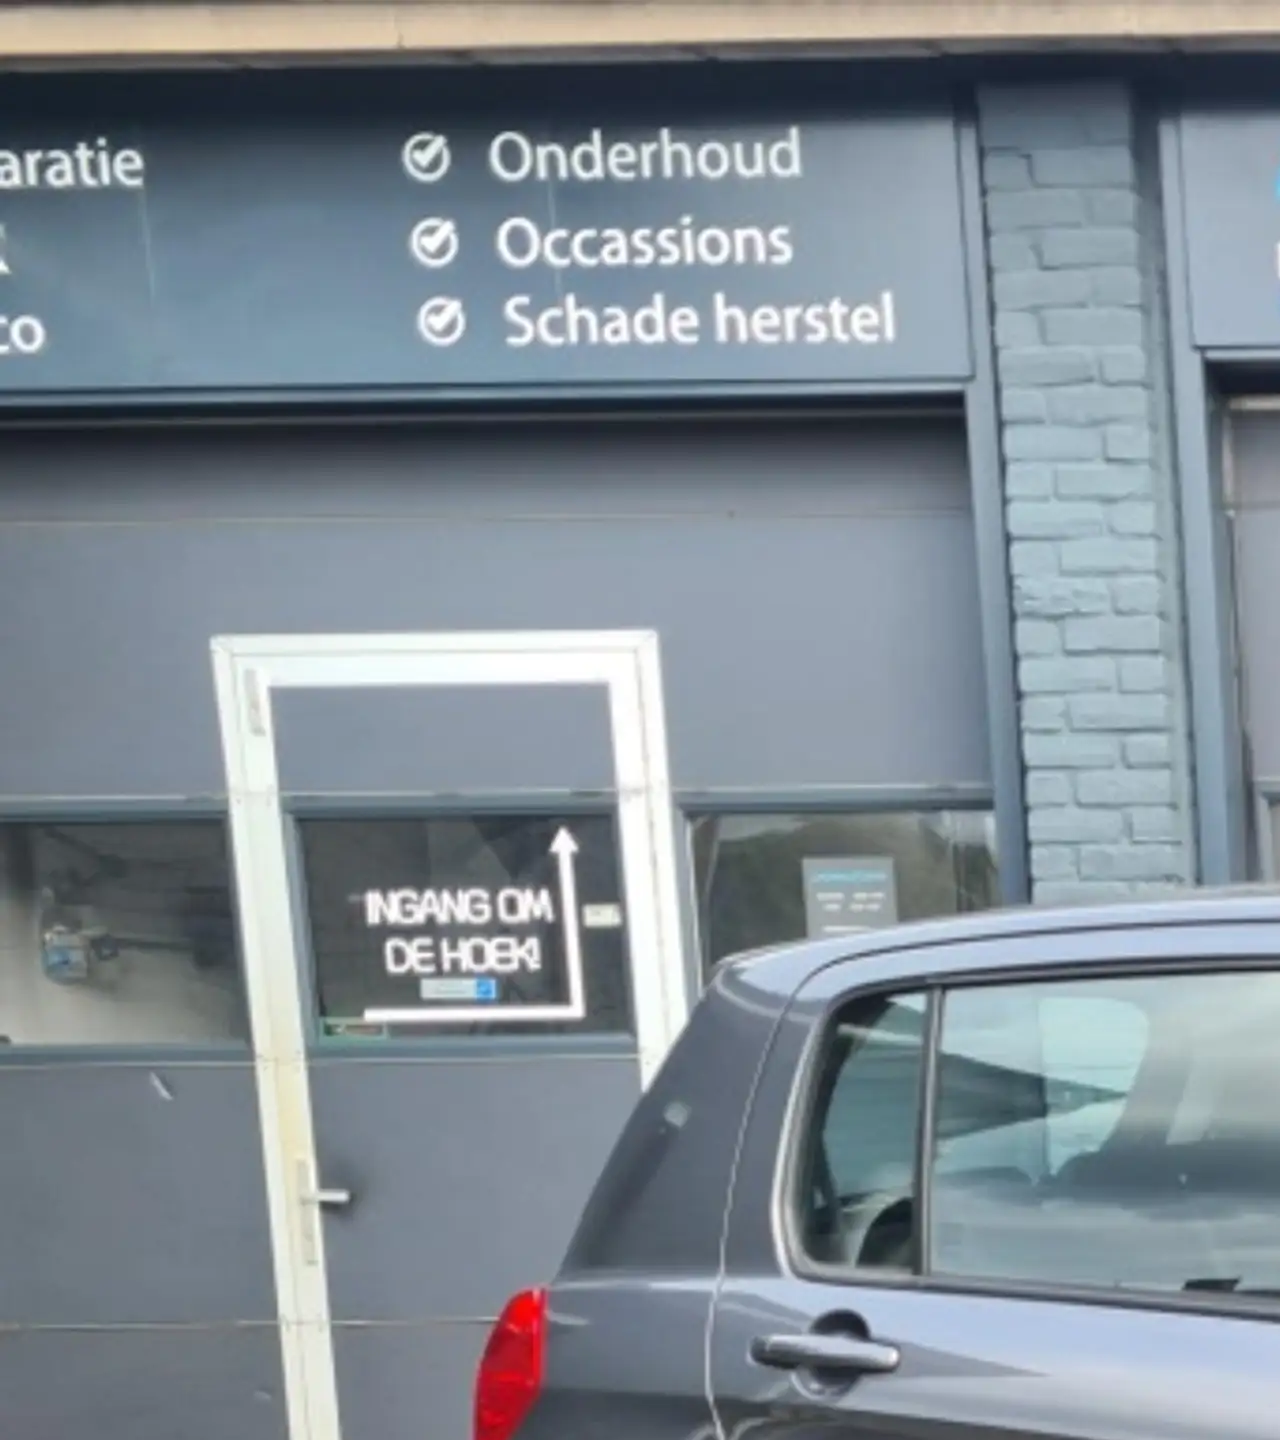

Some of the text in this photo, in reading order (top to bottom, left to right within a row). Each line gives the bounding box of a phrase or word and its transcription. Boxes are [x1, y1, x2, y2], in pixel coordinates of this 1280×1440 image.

[489, 127, 803, 182] Onderhoud
[497, 216, 794, 268] Occassions
[503, 291, 896, 346] Schade herstel
[365, 887, 491, 926] INGANG
[496, 886, 554, 924] OM
[384, 935, 436, 974] DE
